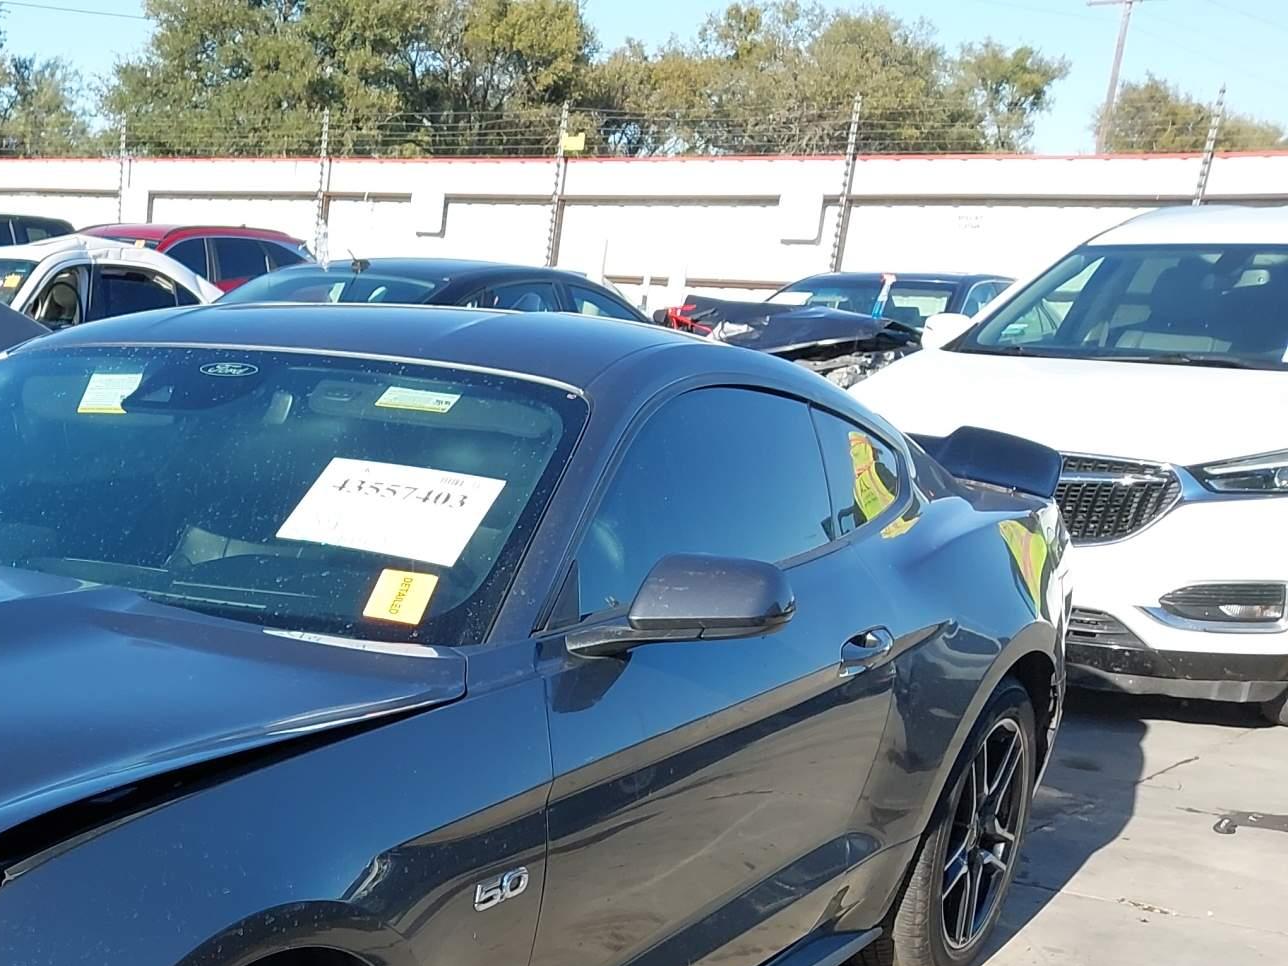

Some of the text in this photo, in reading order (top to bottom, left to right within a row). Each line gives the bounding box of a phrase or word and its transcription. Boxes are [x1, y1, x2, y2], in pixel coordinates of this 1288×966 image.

[206, 363, 251, 376] Ford
[332, 478, 469, 508] 43557403
[388, 577, 414, 615] DETAILED
